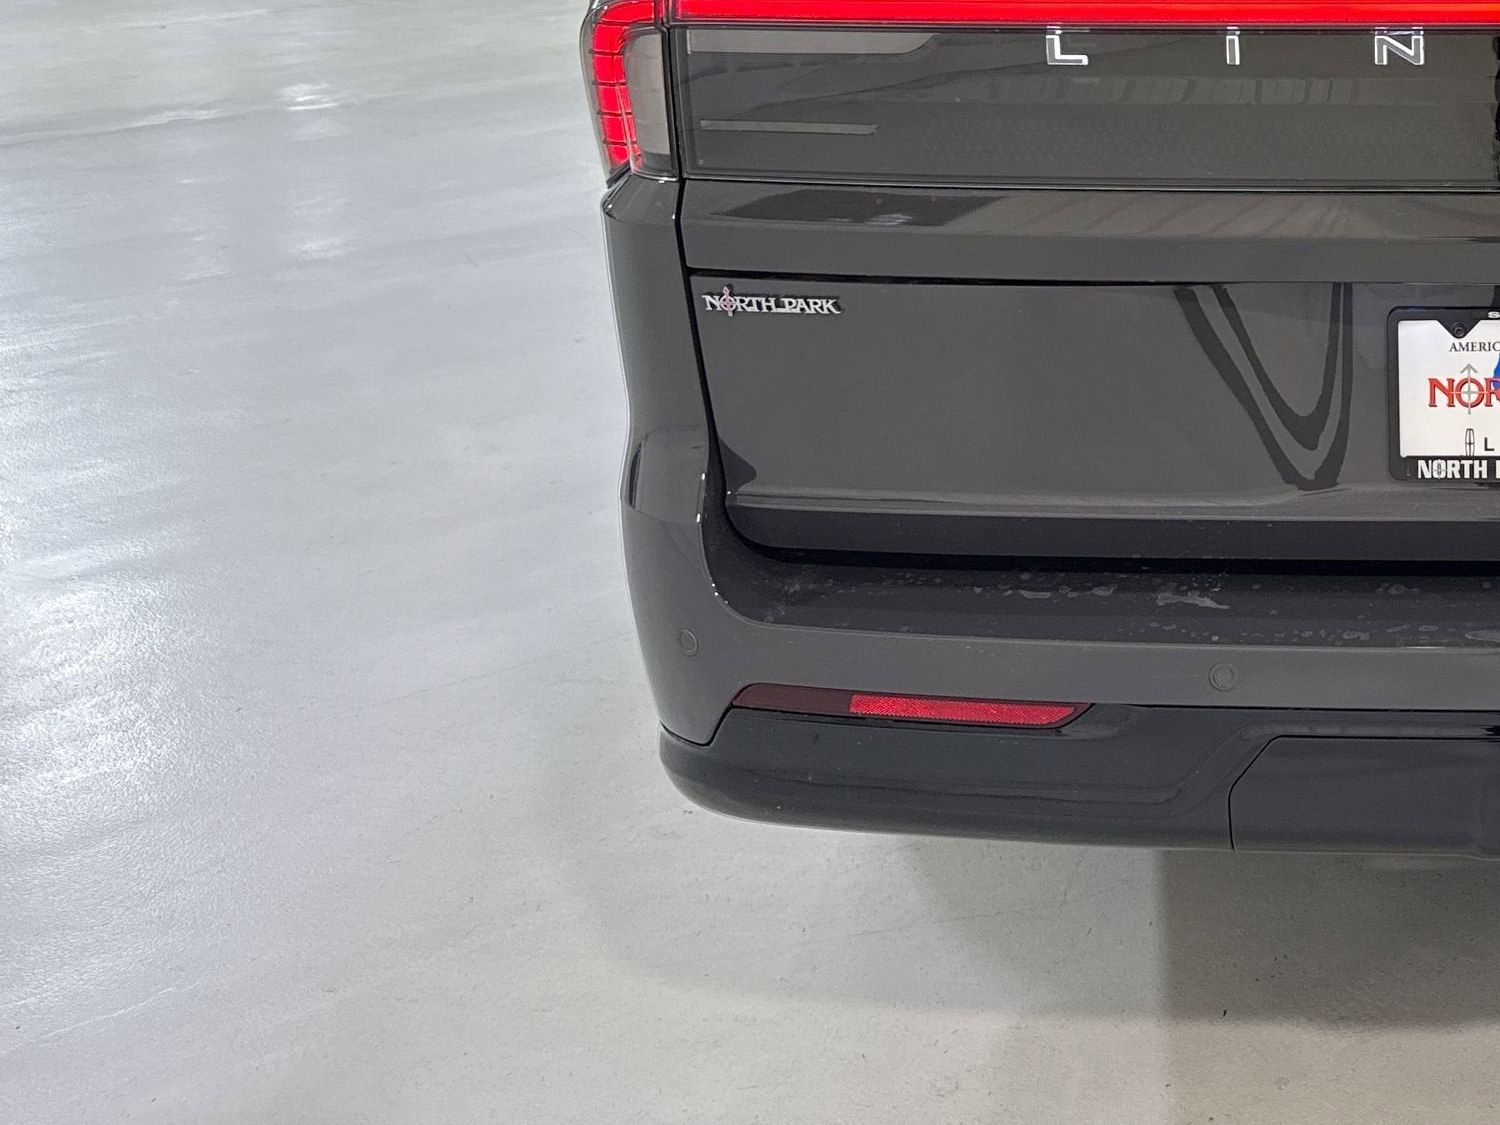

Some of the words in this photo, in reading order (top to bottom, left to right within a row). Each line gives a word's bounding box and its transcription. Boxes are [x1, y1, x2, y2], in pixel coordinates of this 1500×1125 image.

[702, 293, 776, 313] NORTH
[780, 297, 841, 315] PARK
[1417, 458, 1489, 480] NORTH
